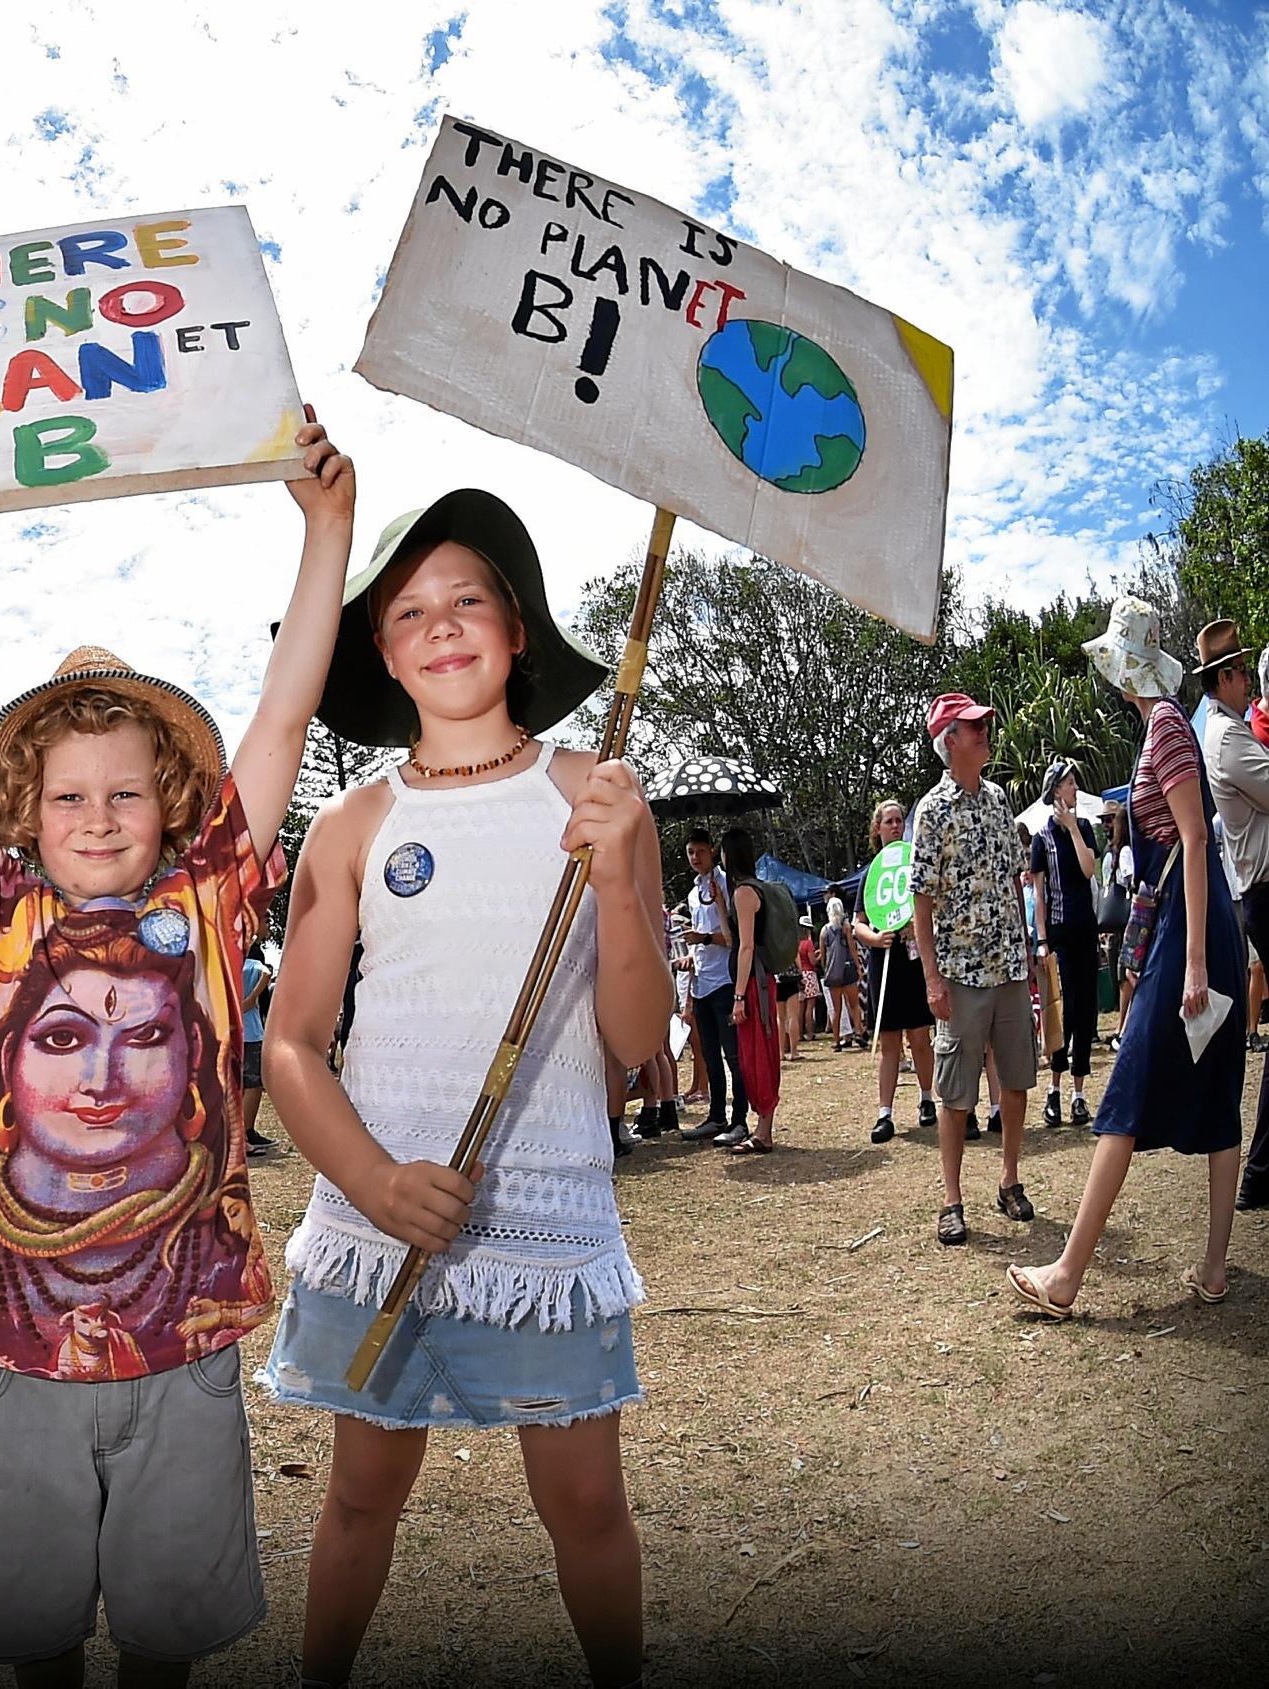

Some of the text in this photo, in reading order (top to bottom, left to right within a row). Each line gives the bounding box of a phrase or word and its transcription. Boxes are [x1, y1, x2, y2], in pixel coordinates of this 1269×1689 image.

[453, 122, 738, 267] THERE IS
[425, 175, 748, 332] NO PLANET
[25, 280, 186, 342] NO
[12, 415, 112, 487] B
[875, 865, 915, 906] GO
